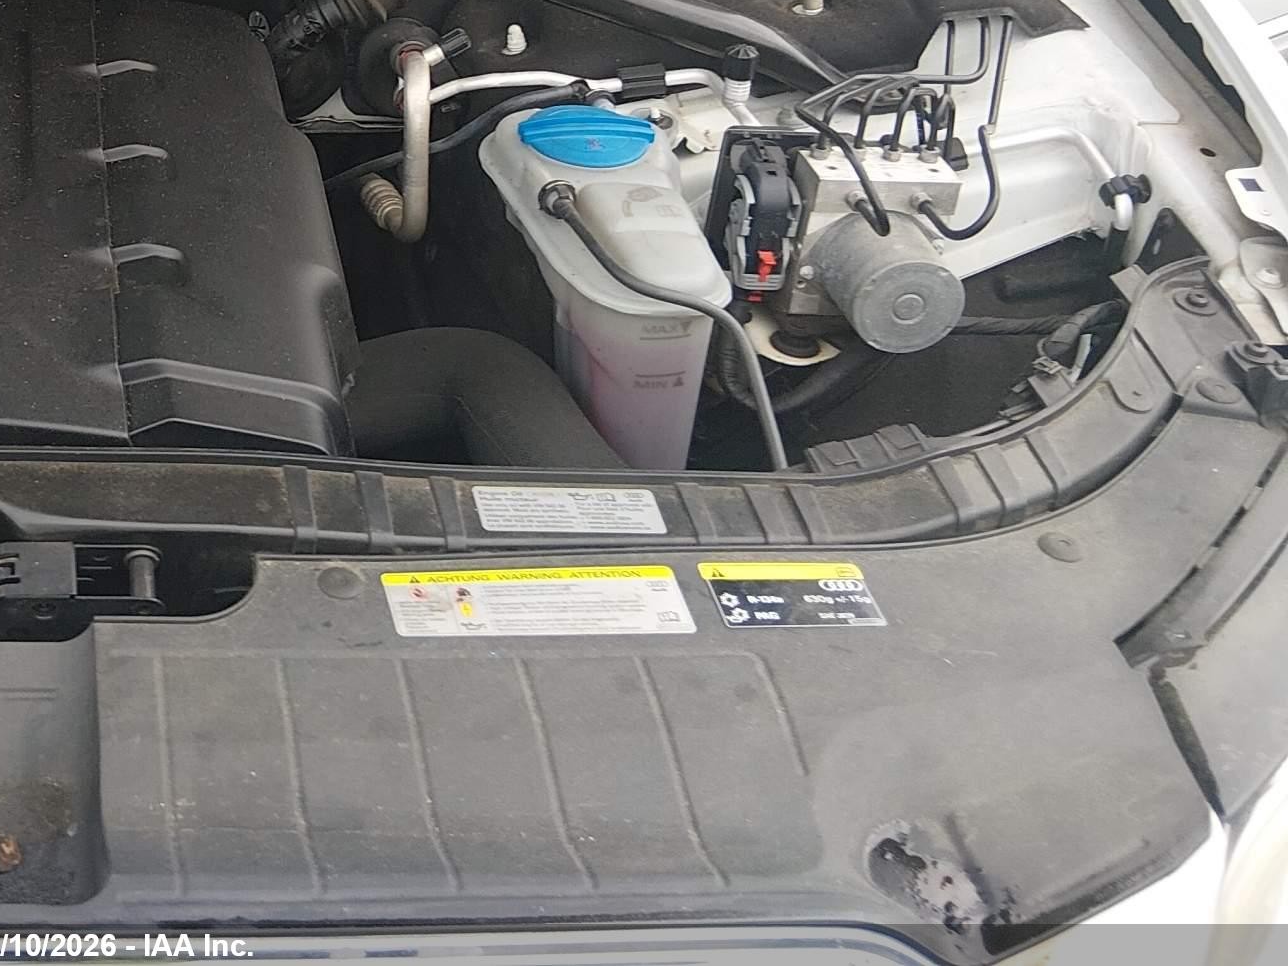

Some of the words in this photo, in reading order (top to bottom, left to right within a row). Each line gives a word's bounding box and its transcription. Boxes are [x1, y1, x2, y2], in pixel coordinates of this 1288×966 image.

[642, 321, 679, 333] MAX
[633, 379, 668, 390] MIN
[427, 574, 490, 583] ACHTUNG
[496, 571, 562, 581] WARNING
[569, 570, 641, 579] ATTENTION
